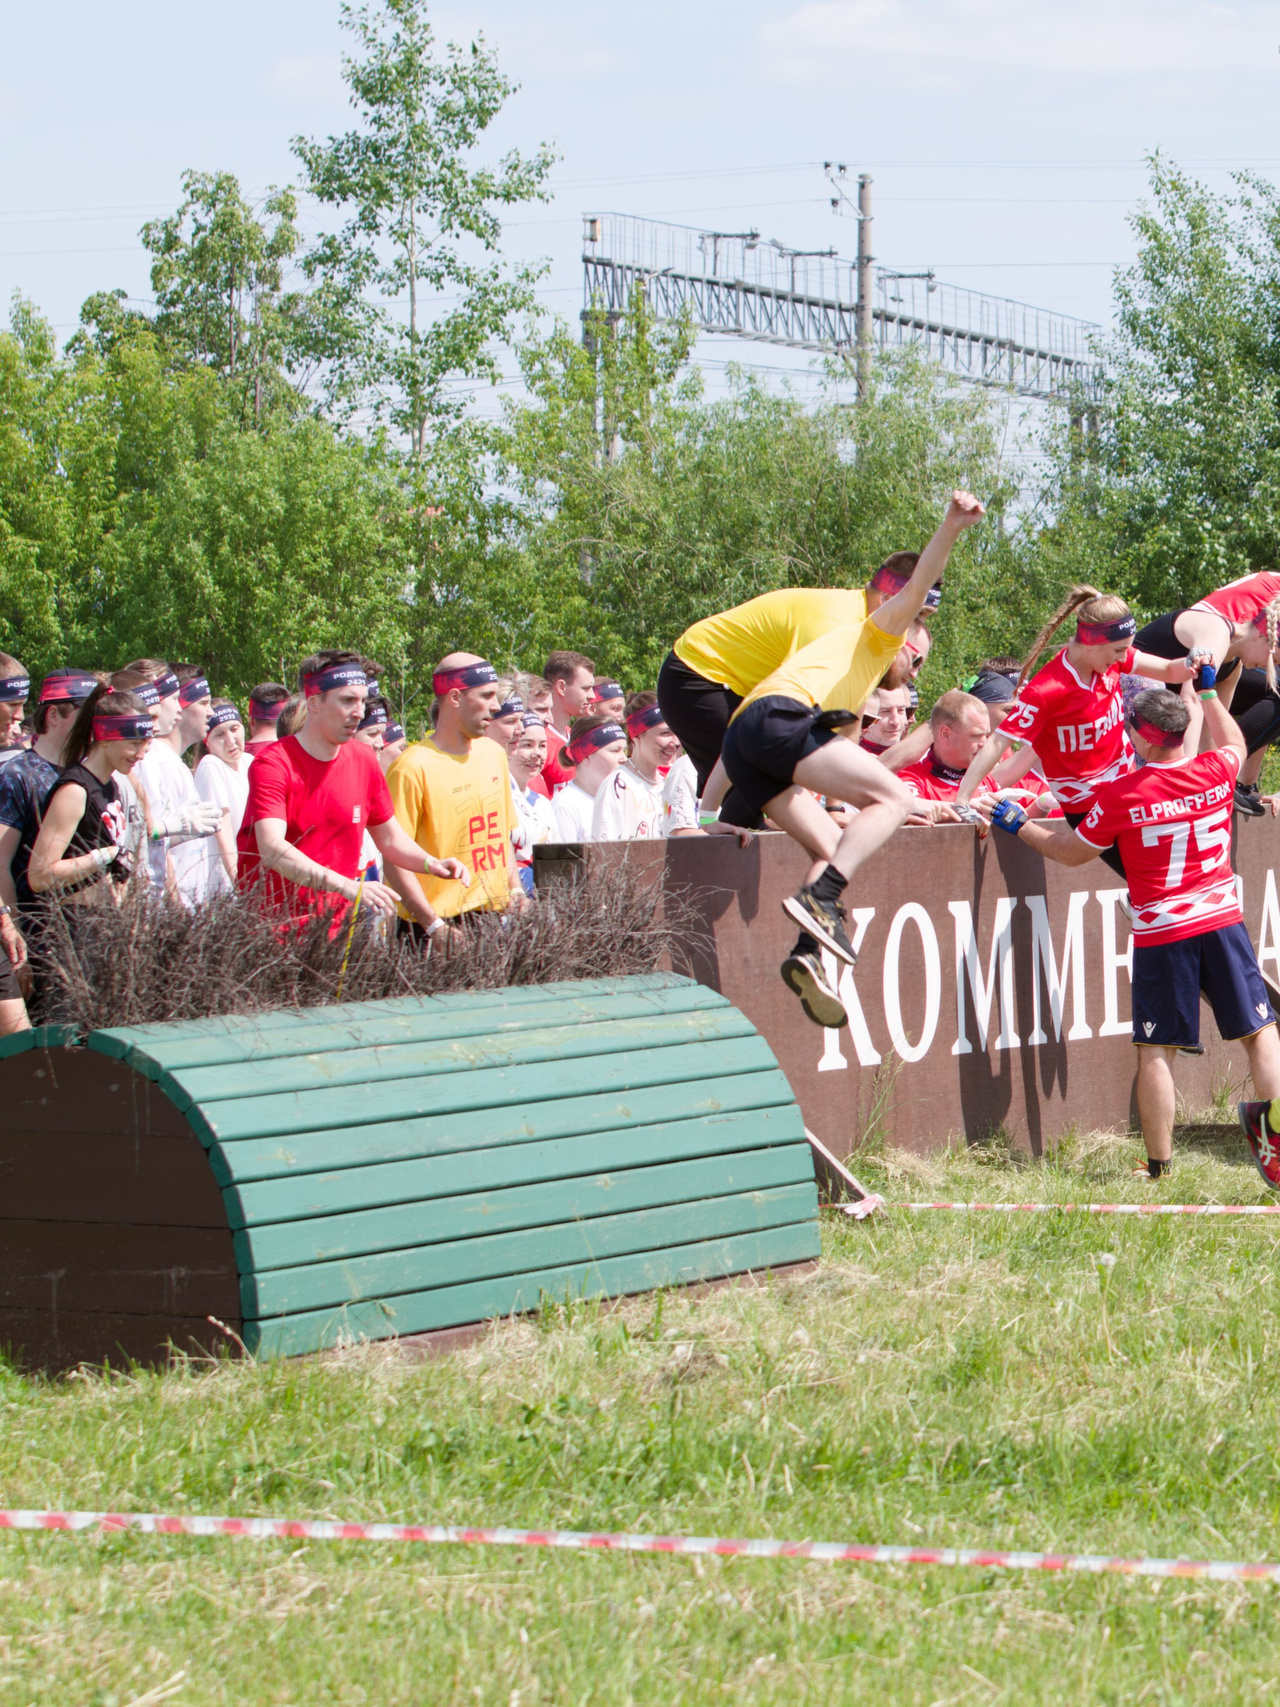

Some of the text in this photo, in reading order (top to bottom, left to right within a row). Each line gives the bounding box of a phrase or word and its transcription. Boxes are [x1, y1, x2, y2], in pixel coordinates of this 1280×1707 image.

[1006, 700, 1040, 729] 75
[469, 811, 502, 845] PE
[472, 843, 507, 874] RM
[1141, 806, 1231, 888] 75
